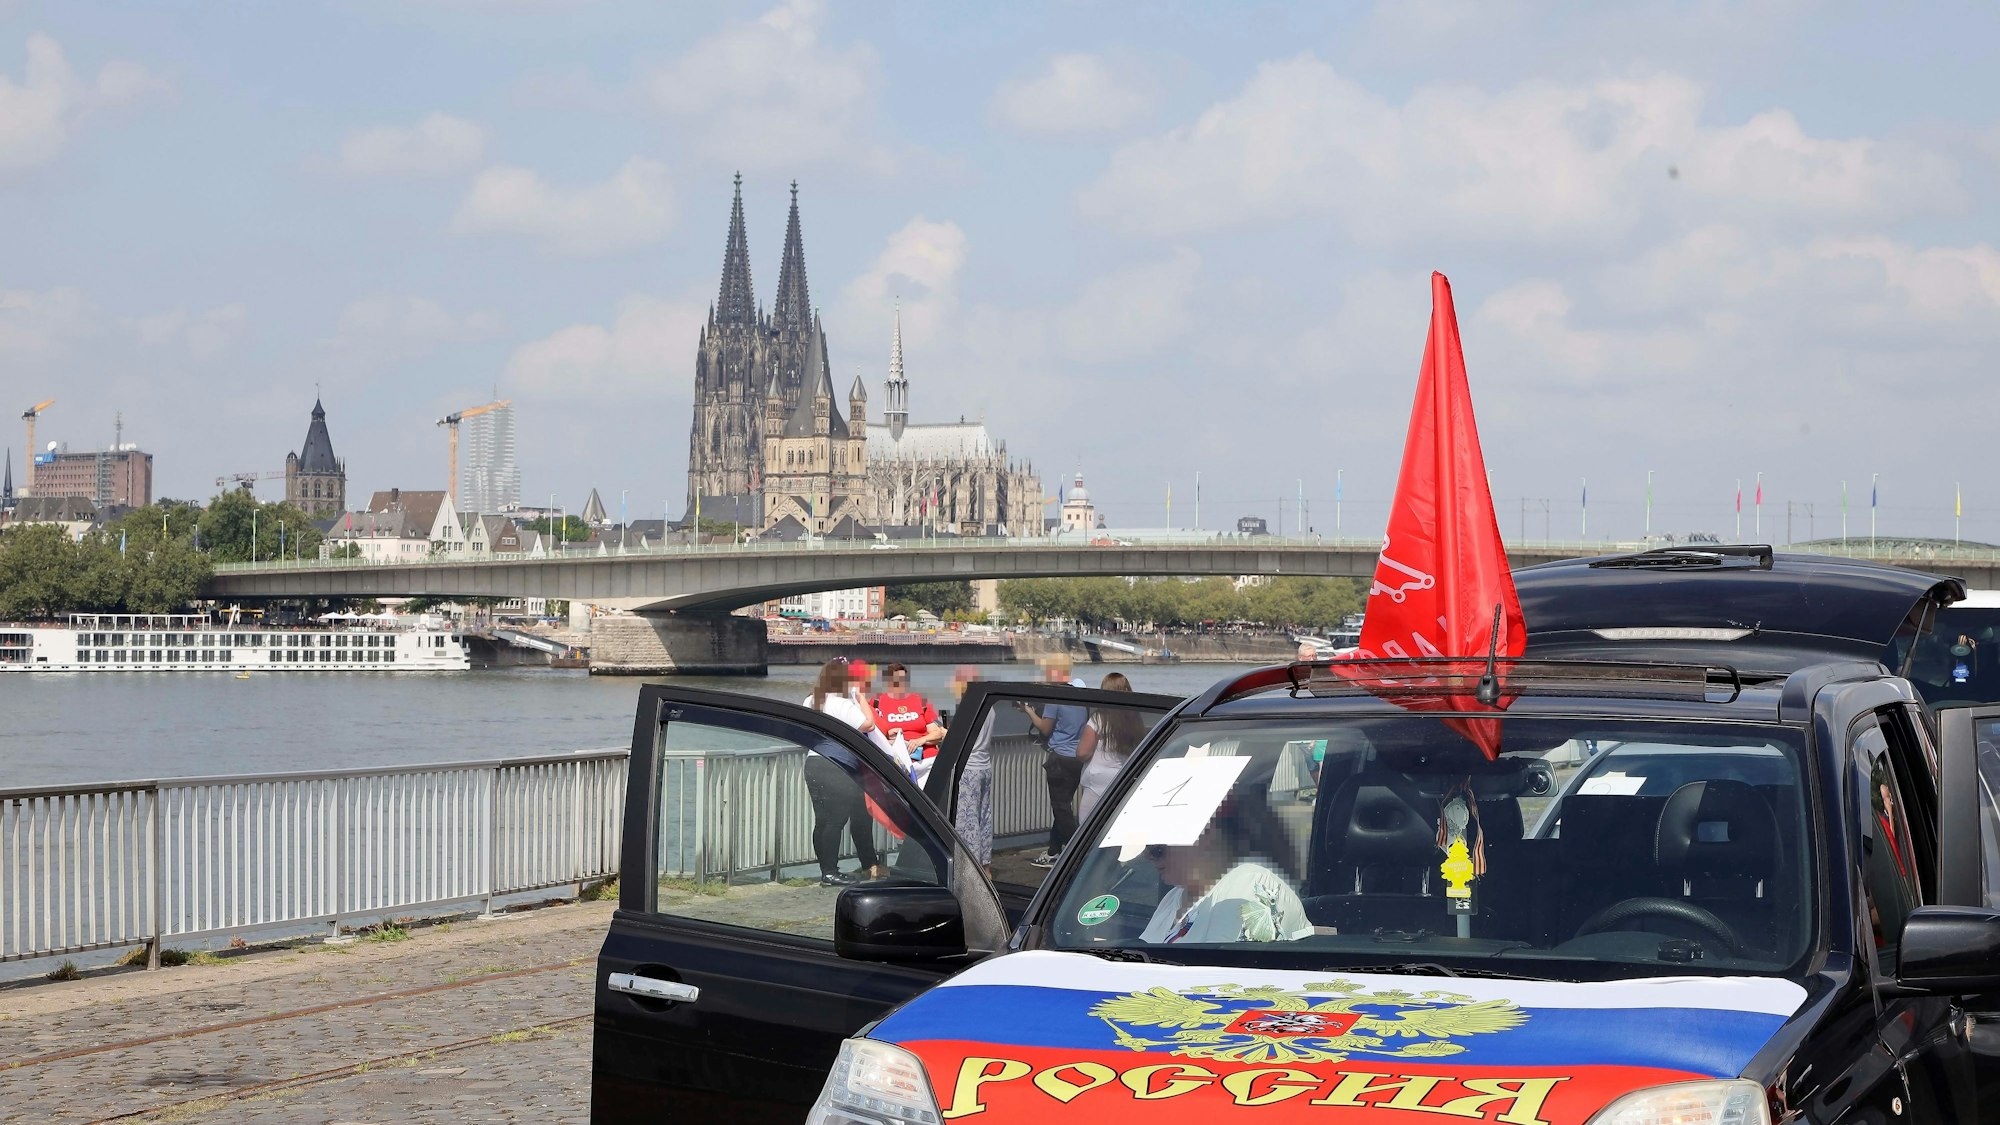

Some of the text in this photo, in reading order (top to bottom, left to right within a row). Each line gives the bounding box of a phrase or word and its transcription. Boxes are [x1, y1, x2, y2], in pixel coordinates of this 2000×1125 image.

[887, 711, 919, 723] СССР
[1151, 776, 1193, 808] 1
[1094, 897, 1108, 911] 4
[941, 1056, 1572, 1125] РОССИЯ
